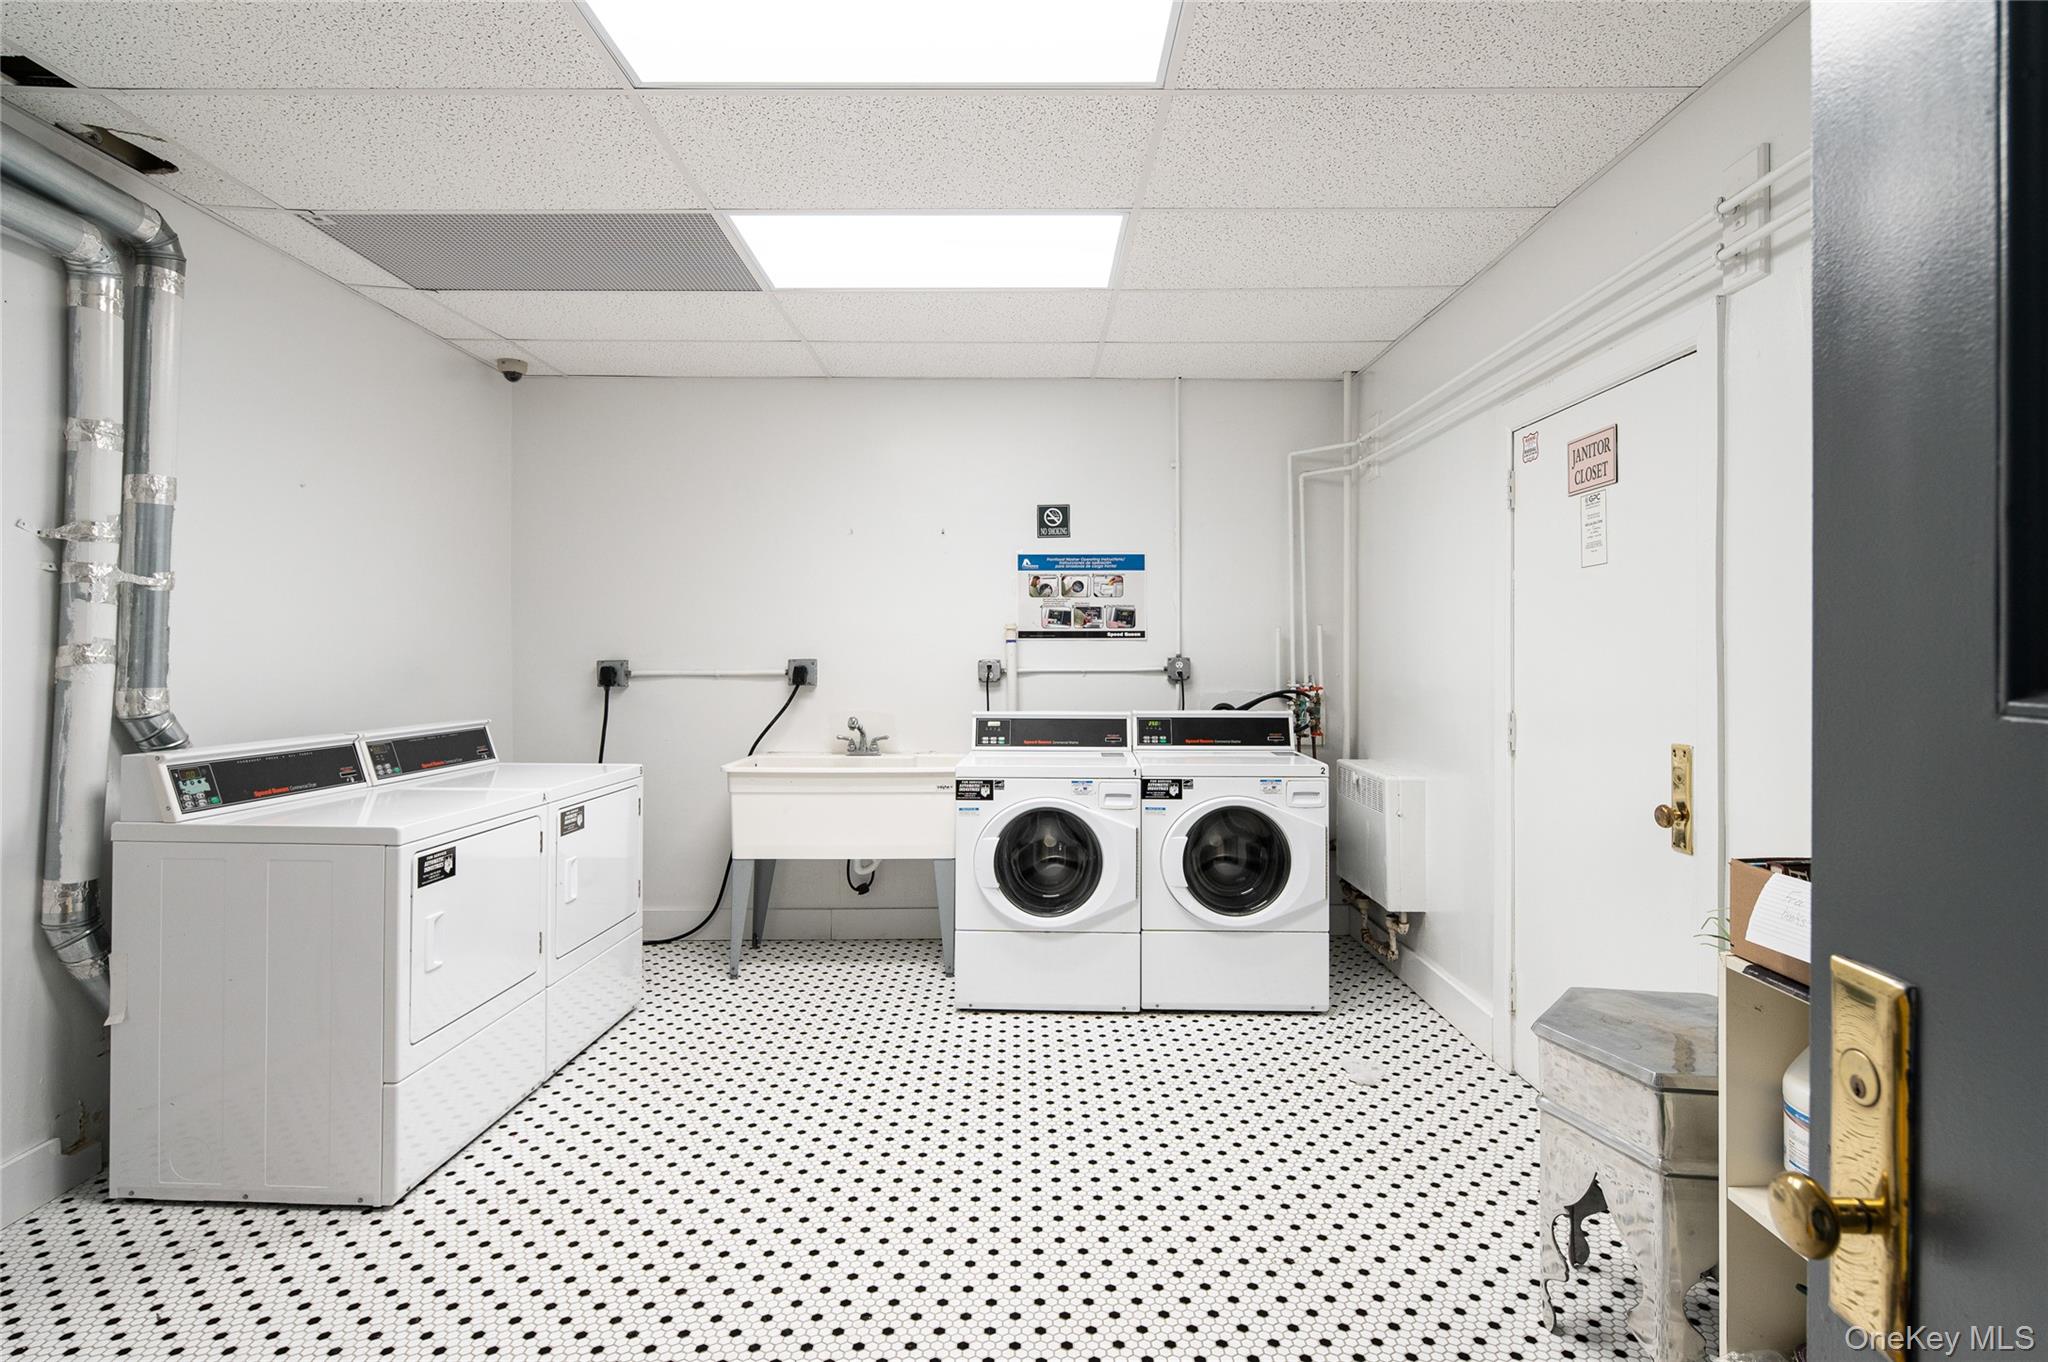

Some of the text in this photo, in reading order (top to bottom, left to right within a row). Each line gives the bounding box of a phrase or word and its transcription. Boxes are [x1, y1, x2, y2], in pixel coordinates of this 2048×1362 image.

[1572, 437, 1611, 469] JANITOR
[1575, 461, 1608, 485] CLOSET
[1040, 527, 1068, 535] NO SMOKING
[1133, 768, 1137, 776] 1
[1320, 767, 1326, 775] 2
